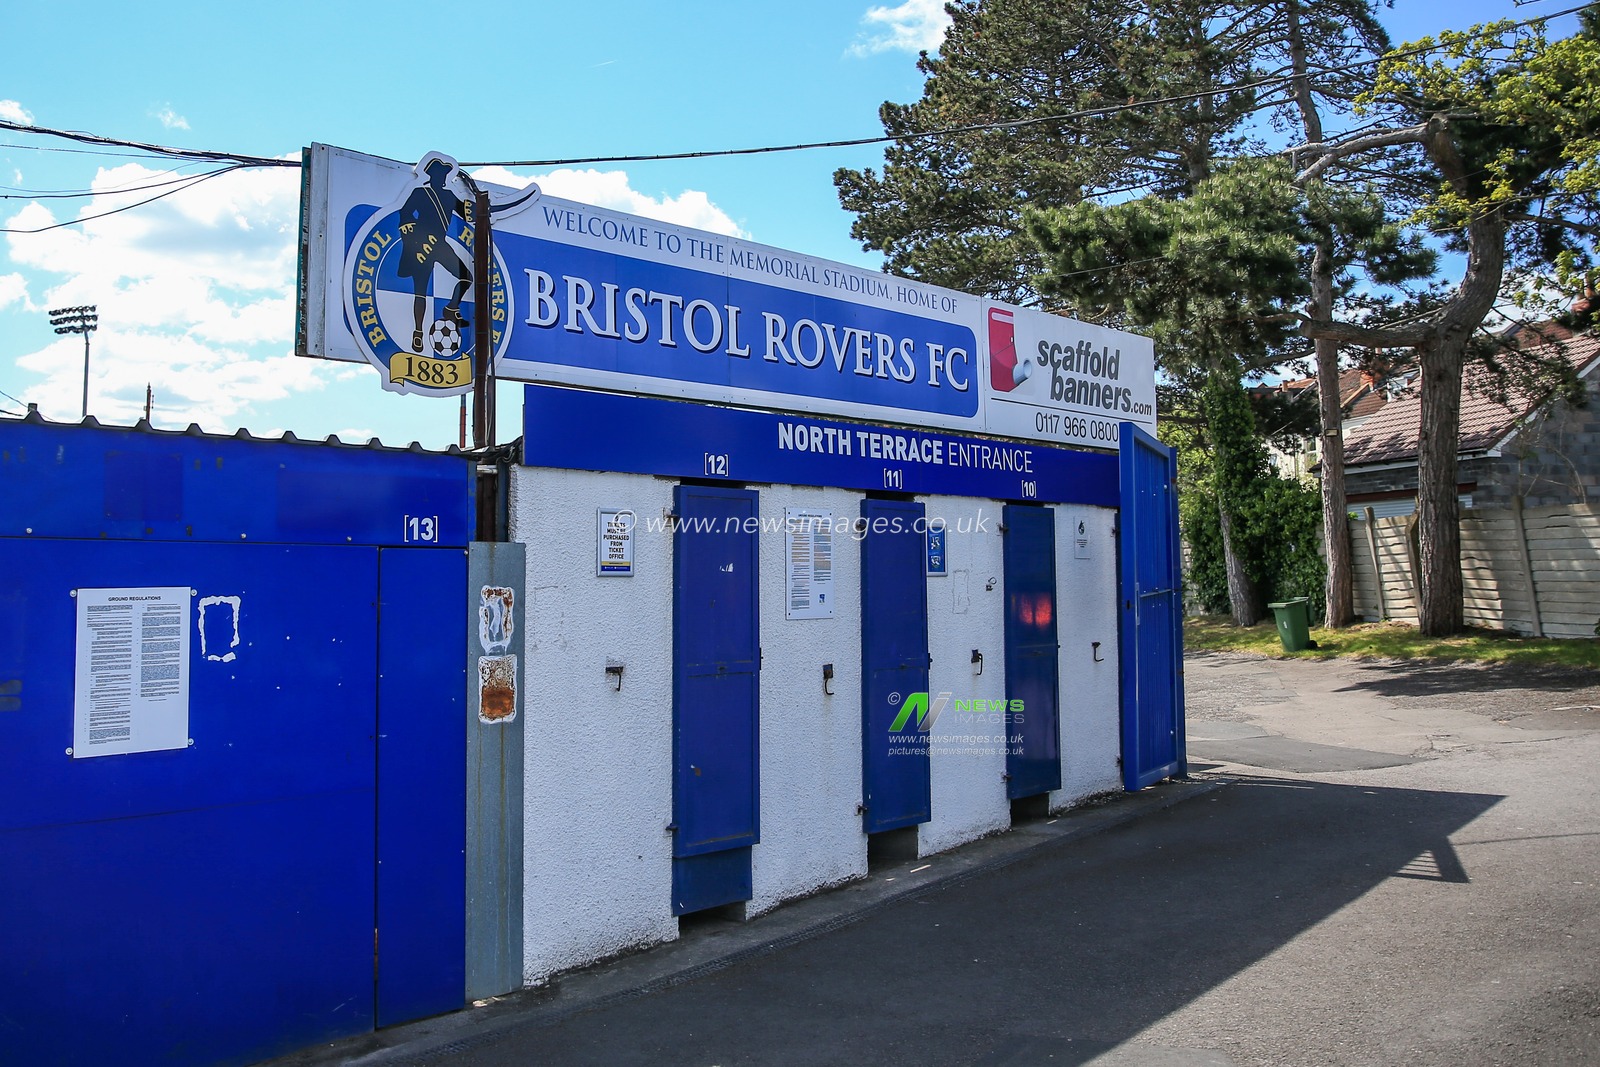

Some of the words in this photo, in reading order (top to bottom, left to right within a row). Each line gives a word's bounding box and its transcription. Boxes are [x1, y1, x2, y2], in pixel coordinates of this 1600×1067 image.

[542, 205, 648, 247] WELCOME
[654, 230, 681, 253] TO
[687, 238, 724, 263] THE
[729, 248, 819, 284] MEMORIAL
[823, 268, 893, 301] STADIUM,
[897, 286, 938, 310] HOME
[941, 296, 958, 314] OF
[355, 230, 392, 348] BRISTOL
[523, 267, 750, 359] BRISTOL
[761, 311, 916, 383] ROVERS
[926, 342, 969, 391] FC
[404, 357, 459, 385] 1883
[1036, 340, 1120, 381] scaffold
[778, 421, 851, 456] NORTH
[856, 431, 944, 464] TERRACE
[948, 442, 1034, 473] ENTRANCE
[1035, 412, 1060, 434] 0117
[1064, 416, 1086, 438] 966
[1090, 420, 1119, 442] 0800
